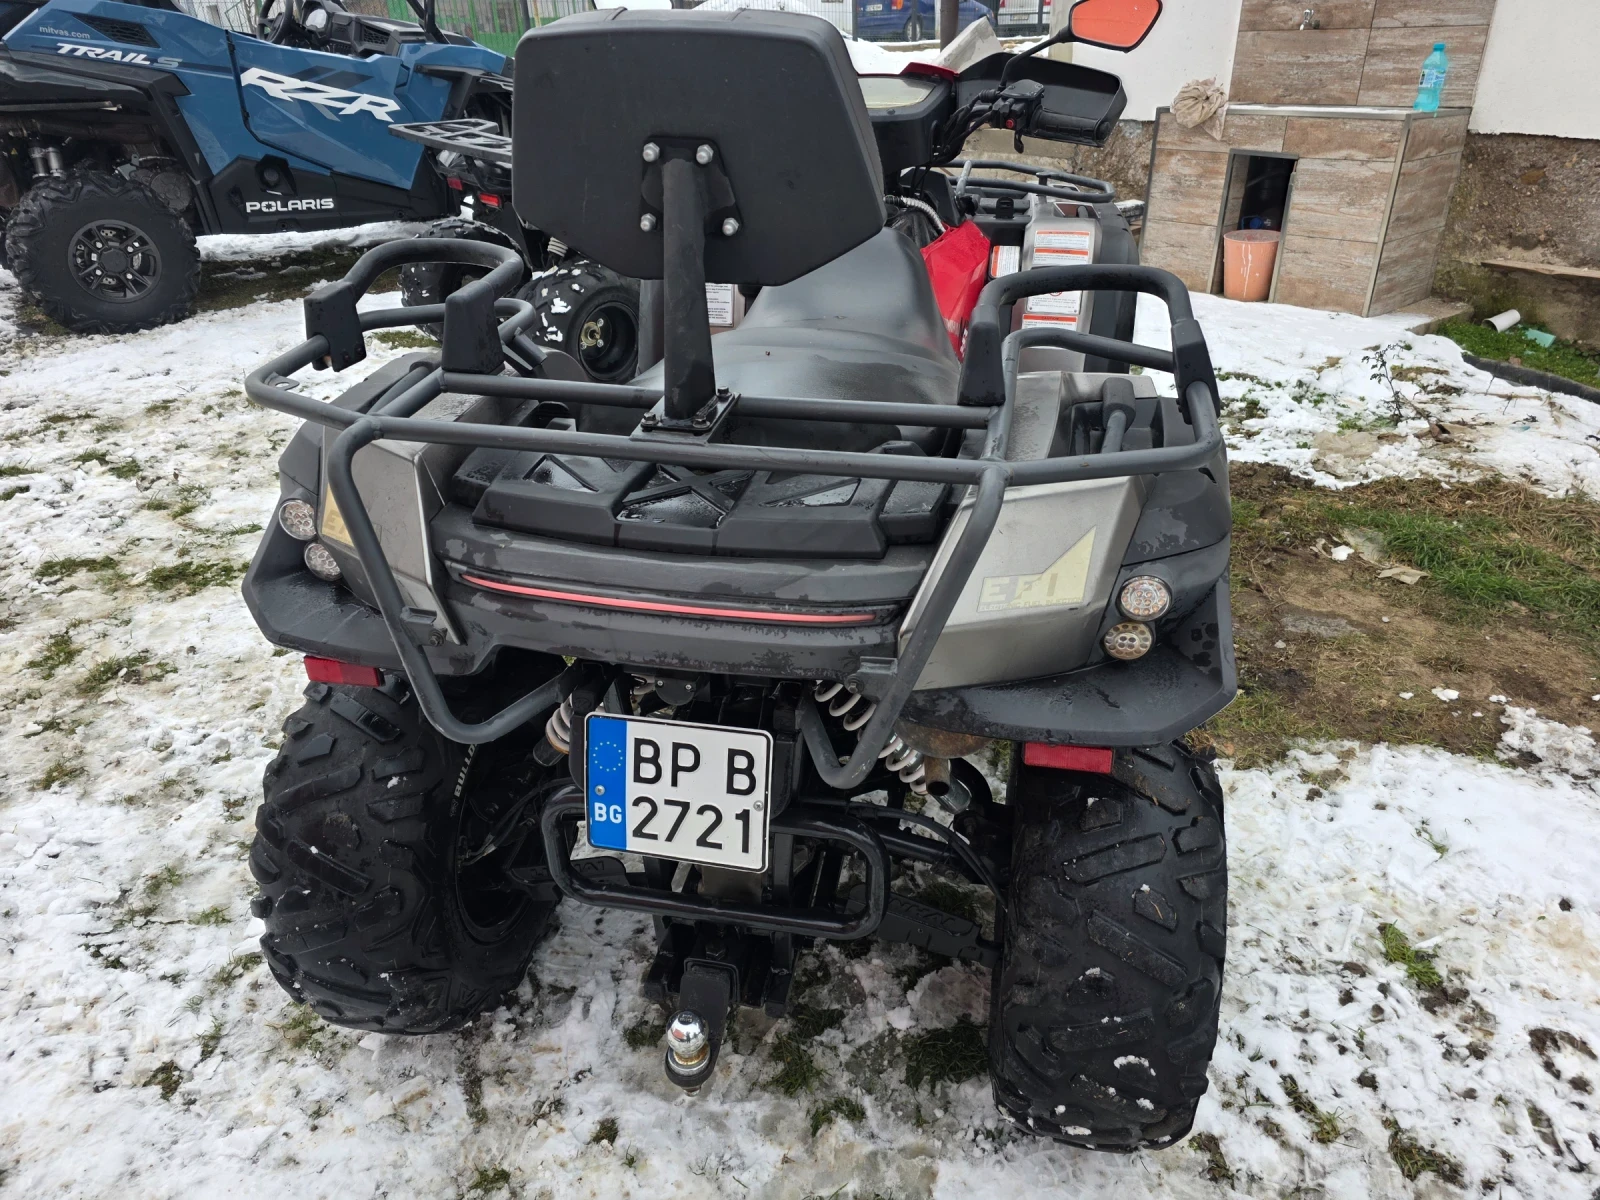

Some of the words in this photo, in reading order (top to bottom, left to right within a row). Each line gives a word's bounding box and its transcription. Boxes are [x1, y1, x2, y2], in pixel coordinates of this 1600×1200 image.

[39, 25, 90, 40] mitvas.com
[56, 42, 151, 65] TRAIL
[152, 56, 183, 68] S
[240, 67, 401, 122] RZR
[245, 198, 335, 213] POLARIS
[633, 737, 701, 788] BP
[726, 748, 757, 796] B
[594, 802, 623, 824] BG
[631, 796, 751, 854] 2721
